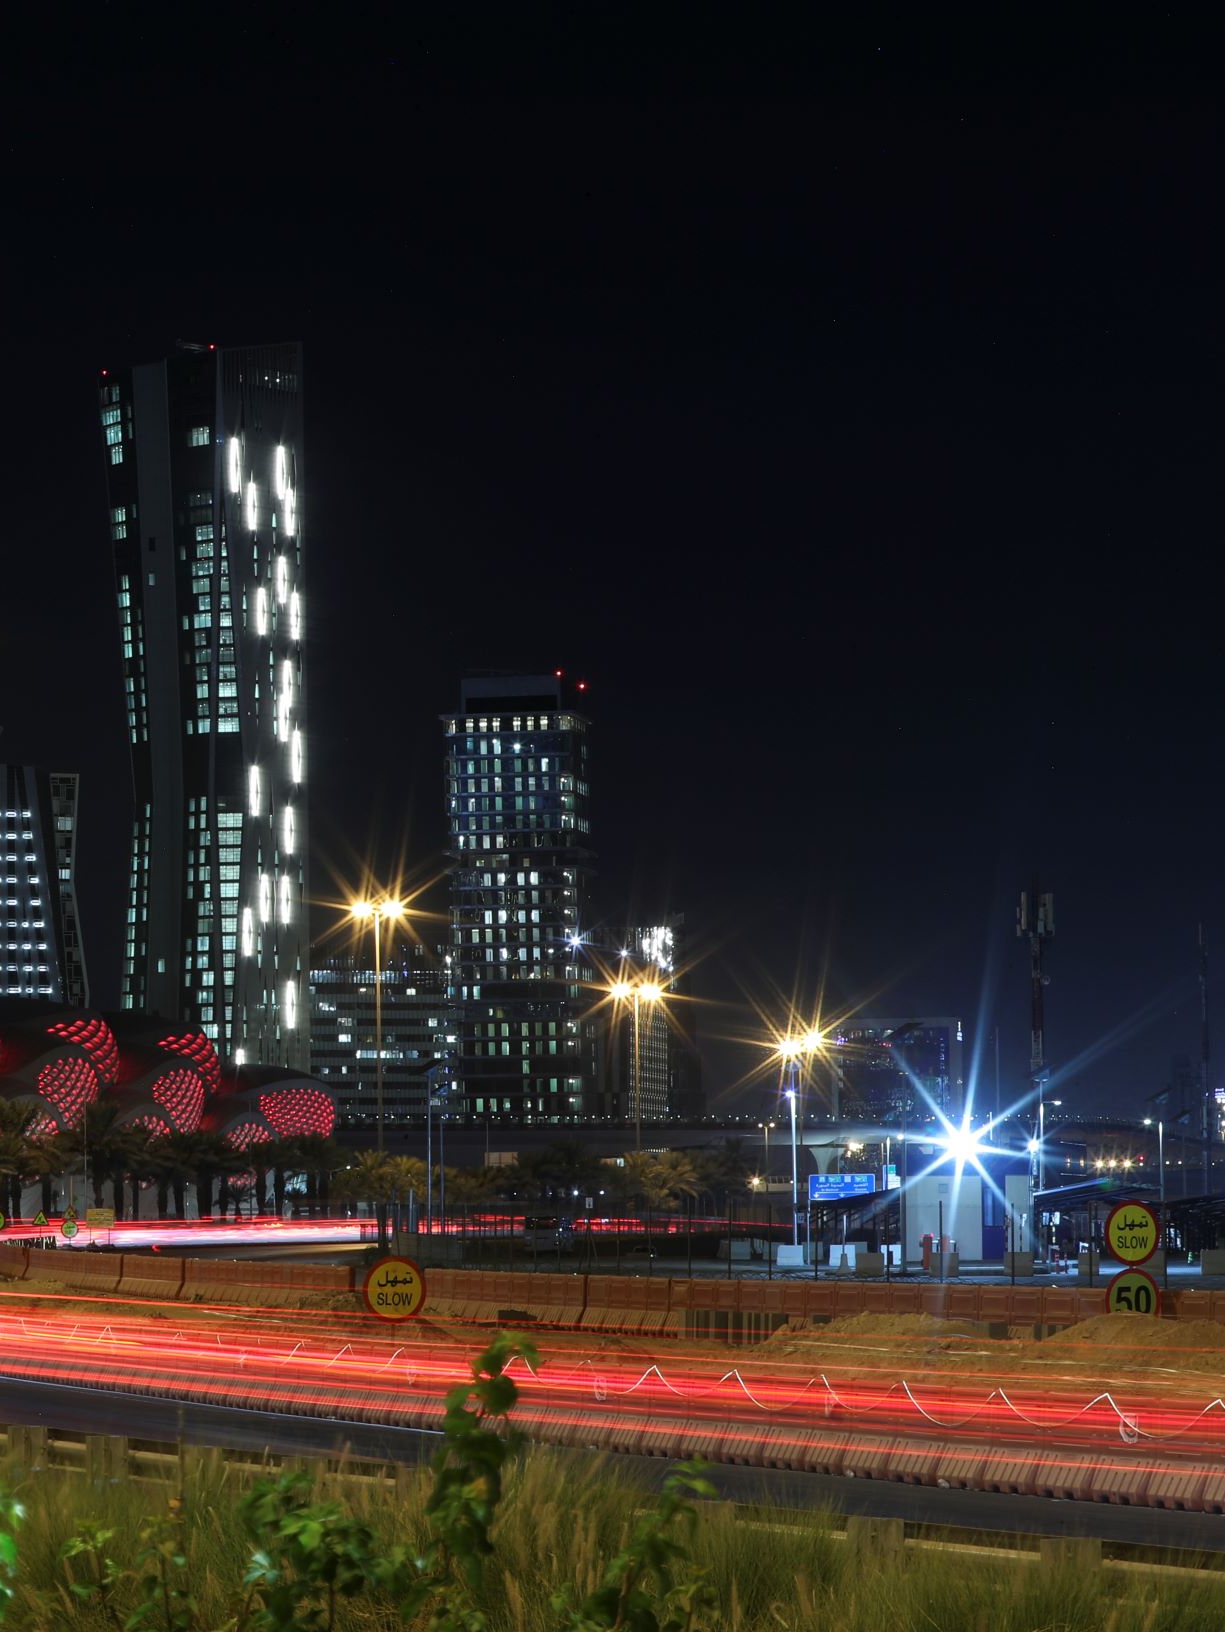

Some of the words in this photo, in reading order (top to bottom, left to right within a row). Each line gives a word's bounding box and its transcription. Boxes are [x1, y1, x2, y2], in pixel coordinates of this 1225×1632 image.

[1117, 1214, 1149, 1231] تمهل
[1117, 1236, 1149, 1249] SLOW
[377, 1270, 413, 1288] تمهل
[376, 1292, 413, 1306] SLOW
[1115, 1285, 1152, 1314] 50
